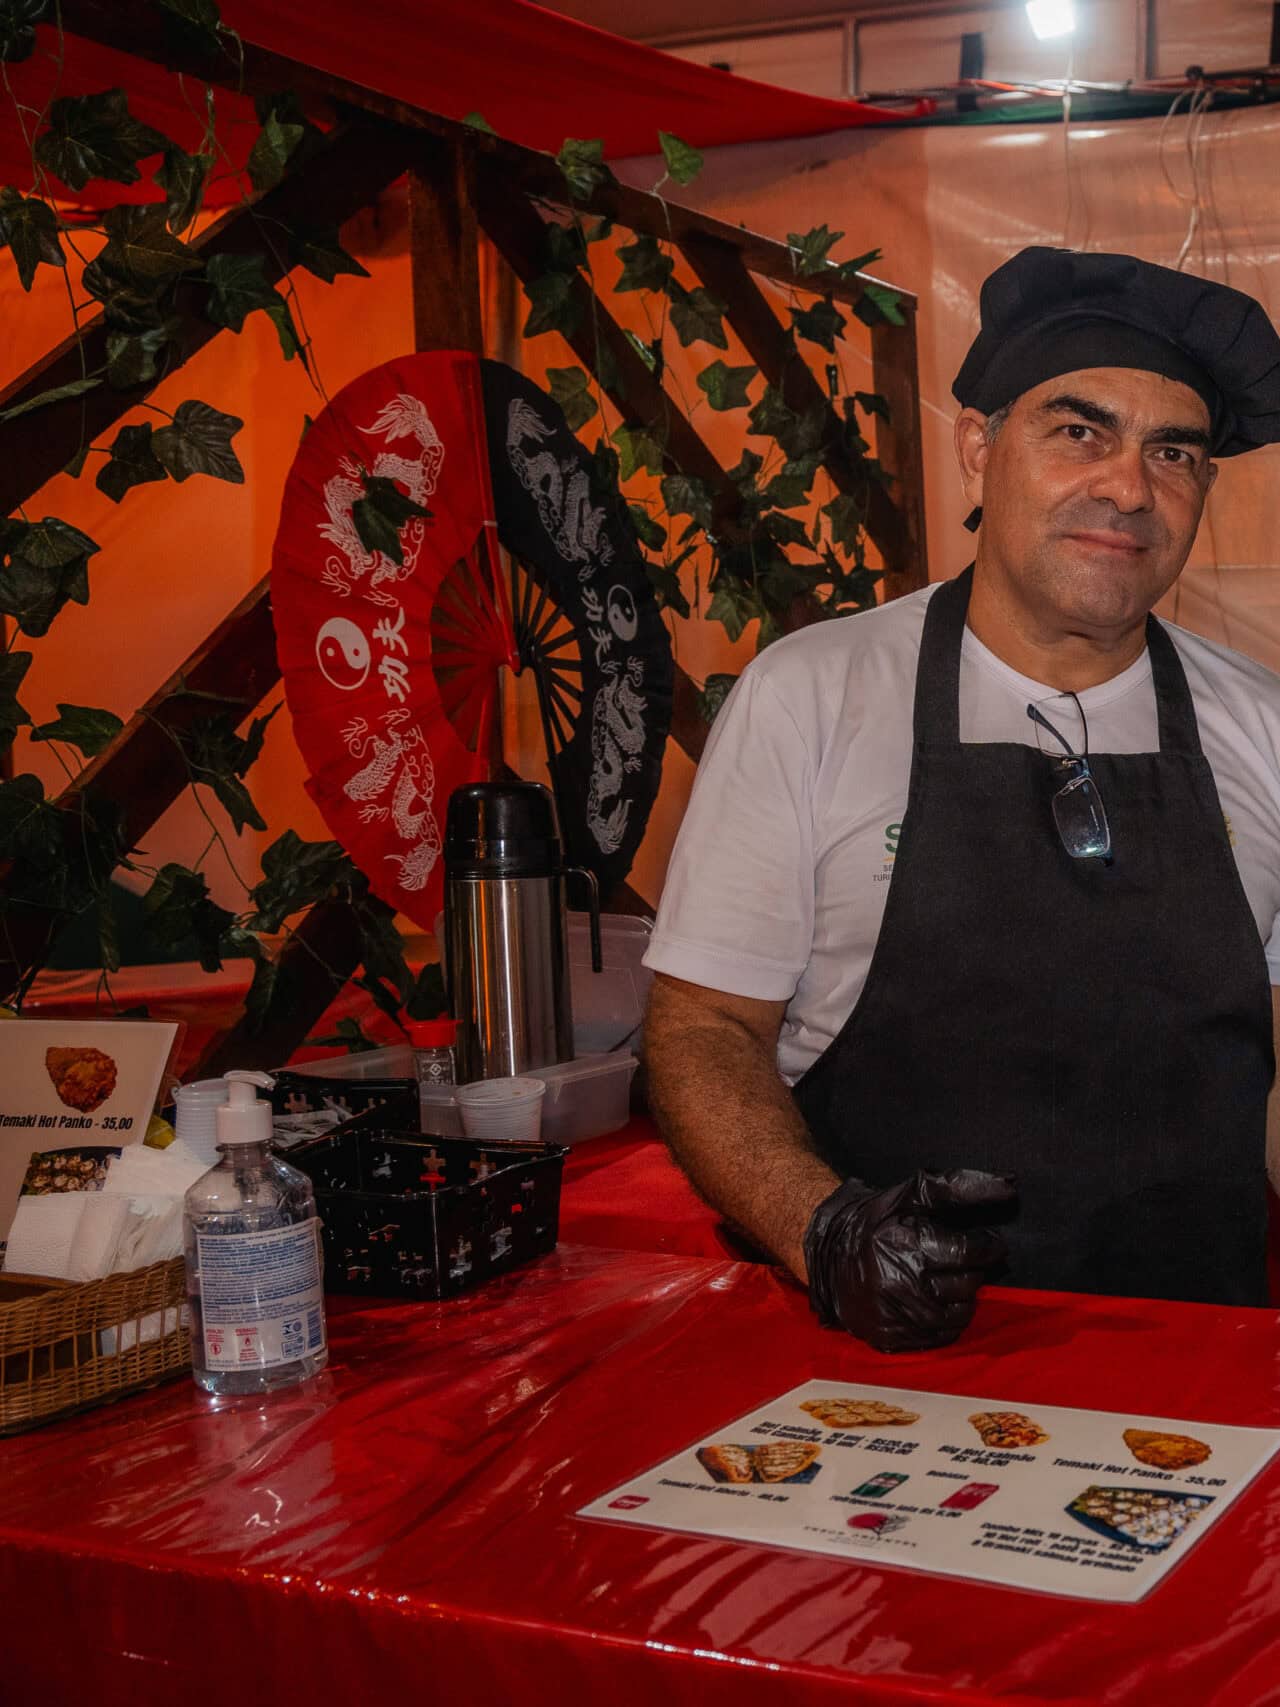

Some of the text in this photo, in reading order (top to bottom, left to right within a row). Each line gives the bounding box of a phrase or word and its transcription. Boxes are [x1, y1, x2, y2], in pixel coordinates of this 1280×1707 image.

[0, 1114, 37, 1128] Temaki
[40, 1115, 58, 1128] Hot
[60, 1116, 93, 1129] Panko
[101, 1117, 134, 1131] 35,00
[960, 1447, 987, 1457] Hot
[1052, 1457, 1104, 1472] Temaki
[1103, 1463, 1129, 1475] Hot
[1129, 1467, 1174, 1481] Panko
[1185, 1475, 1227, 1487] 35,00
